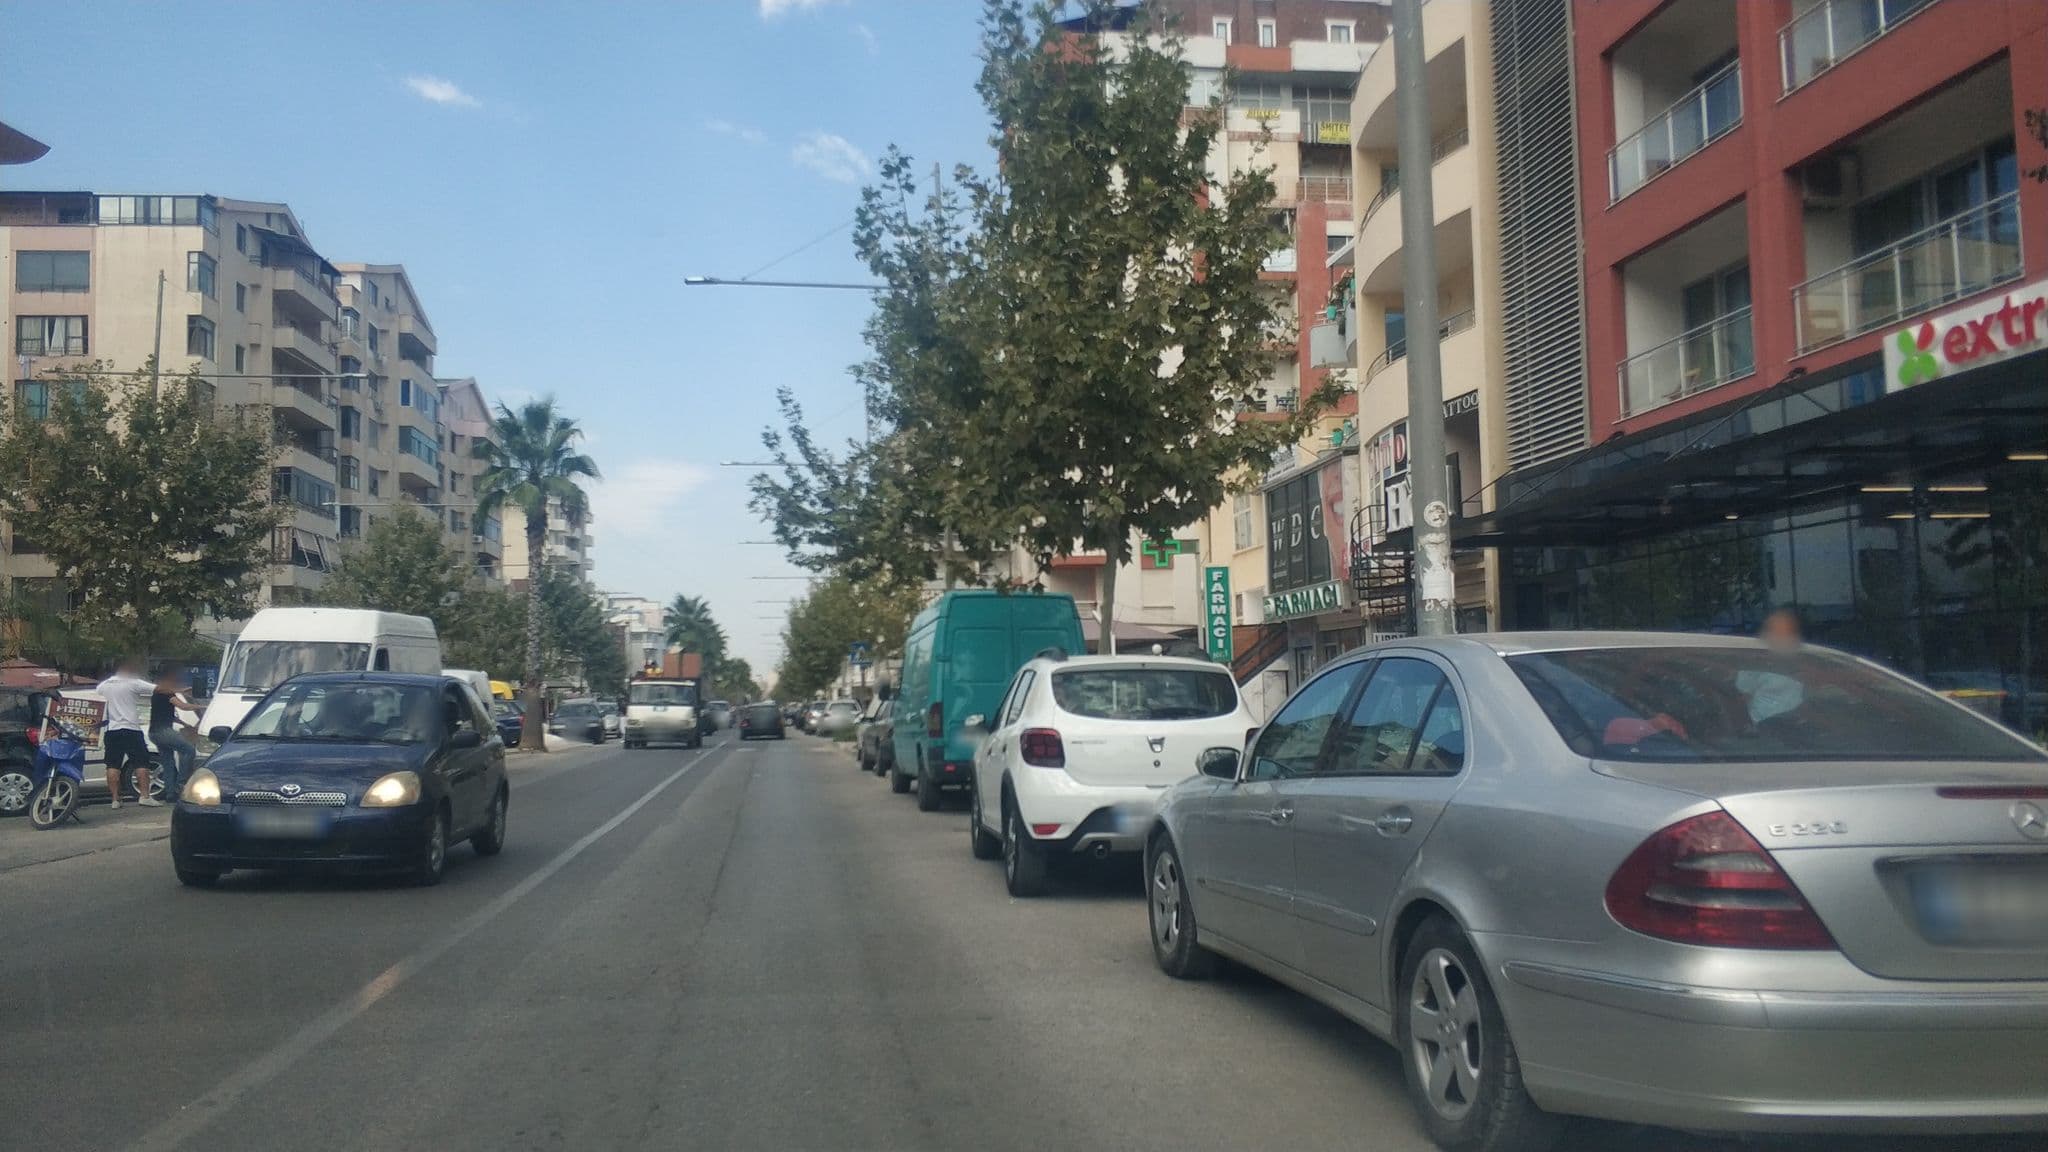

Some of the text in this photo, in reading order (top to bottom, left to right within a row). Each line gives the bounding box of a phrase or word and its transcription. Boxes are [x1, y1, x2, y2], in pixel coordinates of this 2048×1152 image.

[1943, 296, 2047, 364] extr
[1442, 392, 1479, 418] ATTOO
[1210, 571, 1227, 649] FARMACI
[1274, 583, 1342, 618] FARMACI
[1768, 823, 1786, 837] E
